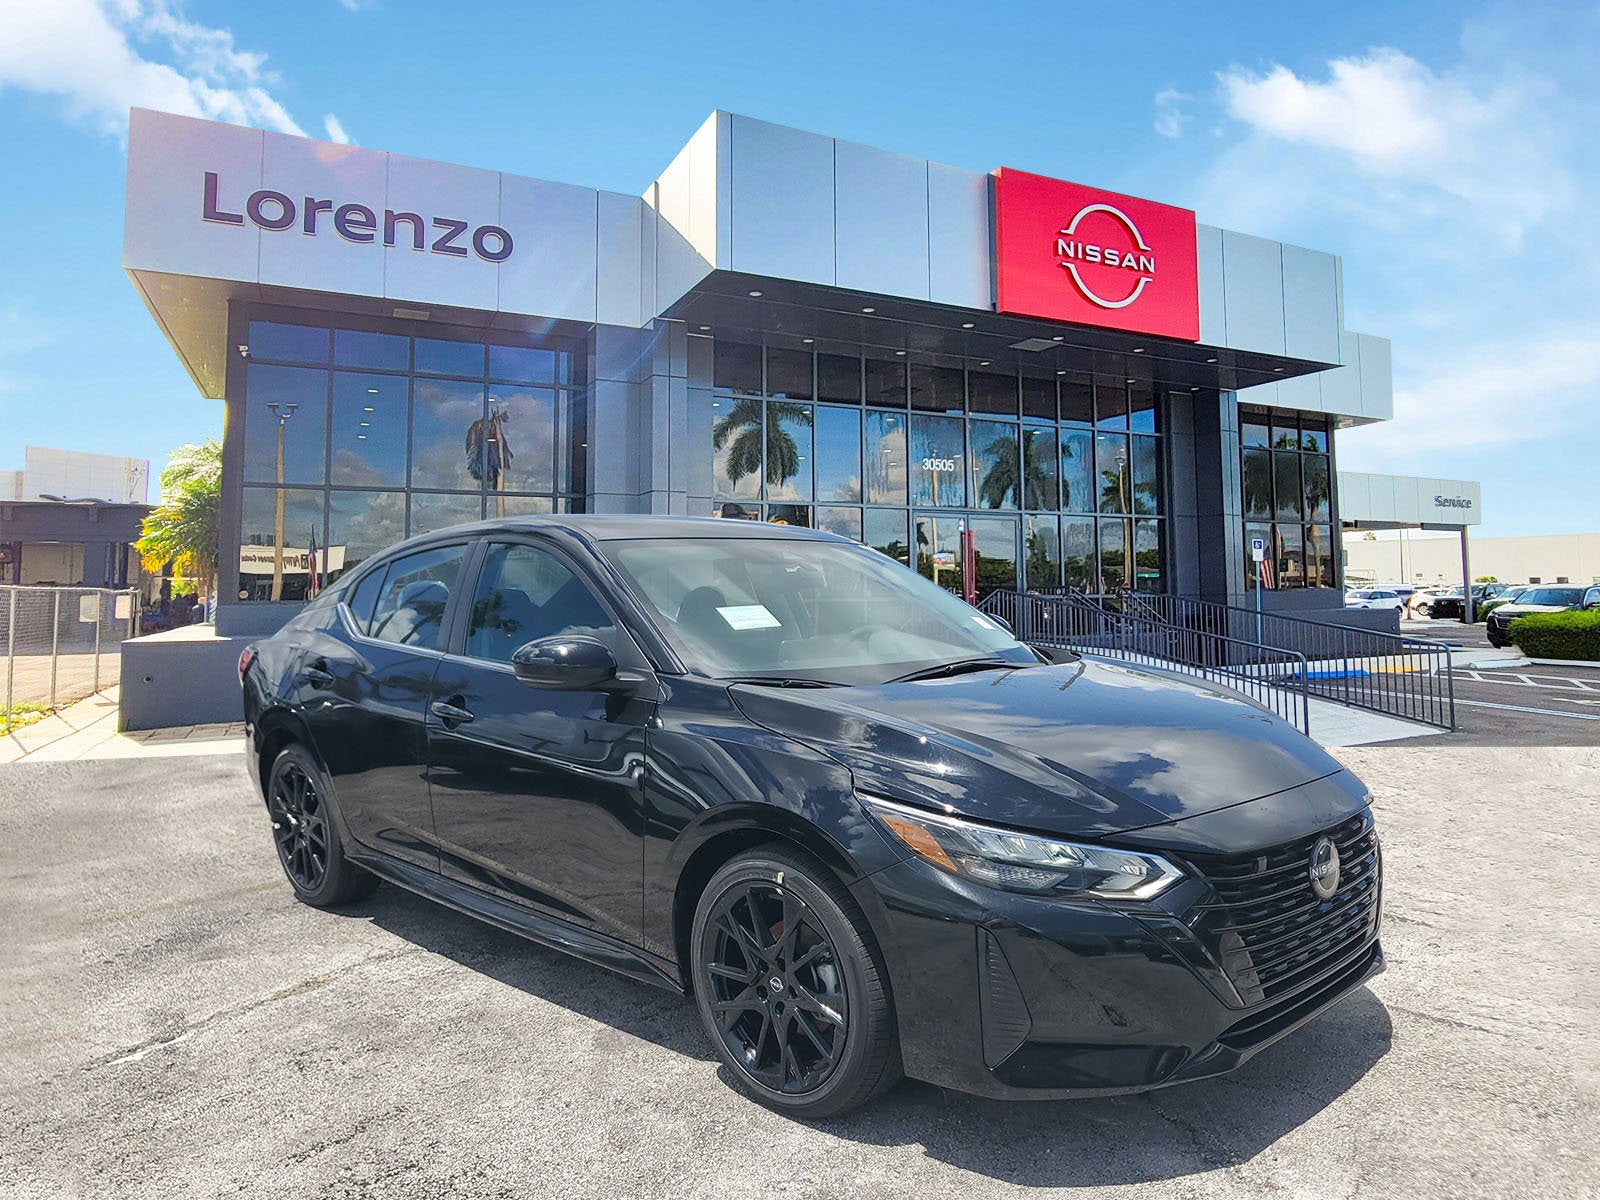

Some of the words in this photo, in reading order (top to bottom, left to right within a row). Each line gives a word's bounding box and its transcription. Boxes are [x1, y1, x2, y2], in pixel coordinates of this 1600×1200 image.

[202, 171, 514, 262] Lorenzo
[1057, 238, 1155, 273] NISSAN
[922, 458, 954, 472] 30505
[1434, 495, 1472, 509] Service
